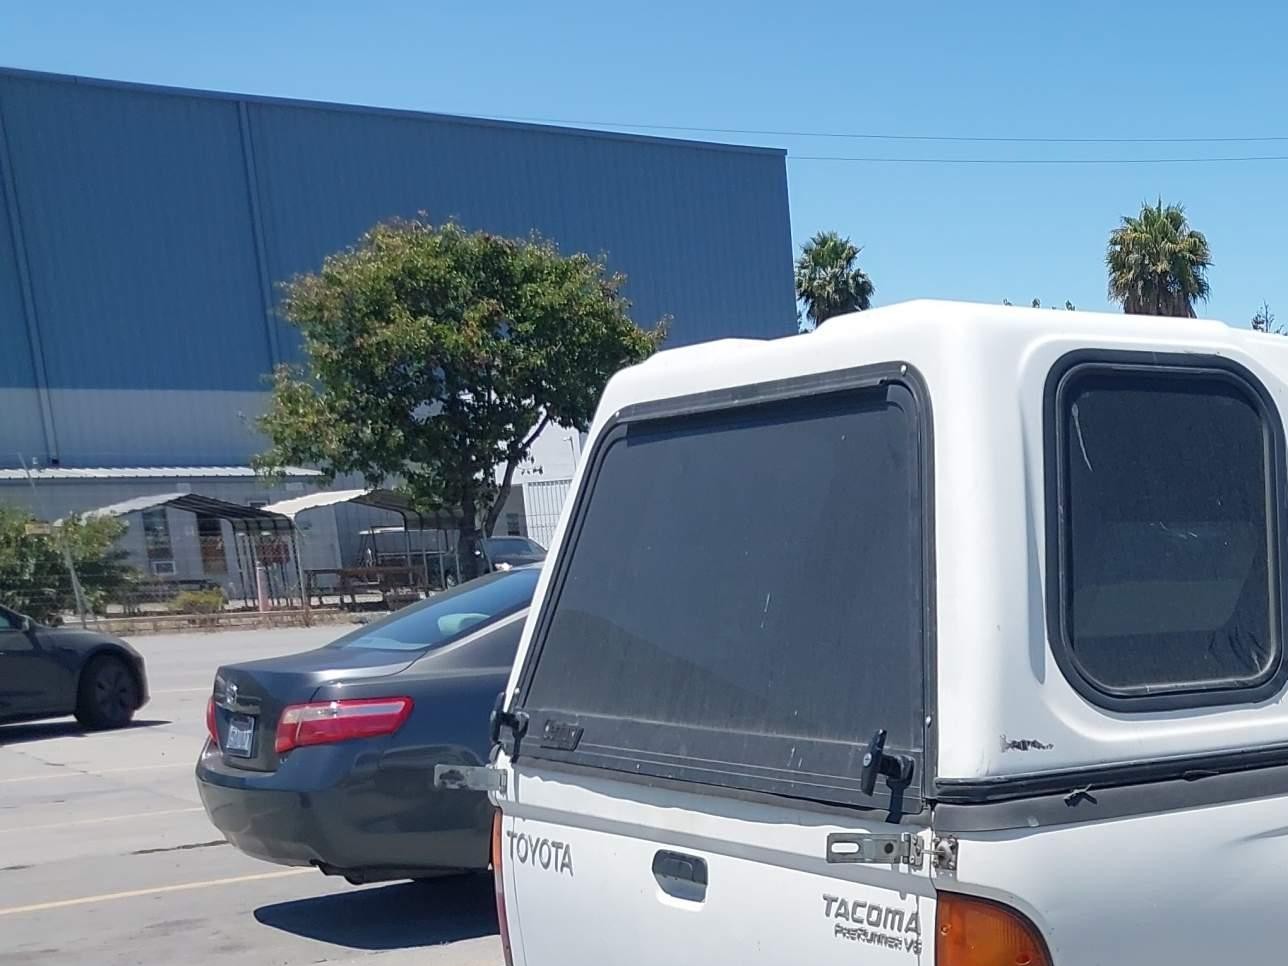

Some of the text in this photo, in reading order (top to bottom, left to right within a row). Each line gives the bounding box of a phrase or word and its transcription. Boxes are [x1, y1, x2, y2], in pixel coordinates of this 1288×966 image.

[506, 829, 574, 877] TOYOTA
[822, 893, 922, 936] TACOMA
[903, 937, 923, 956] V6
